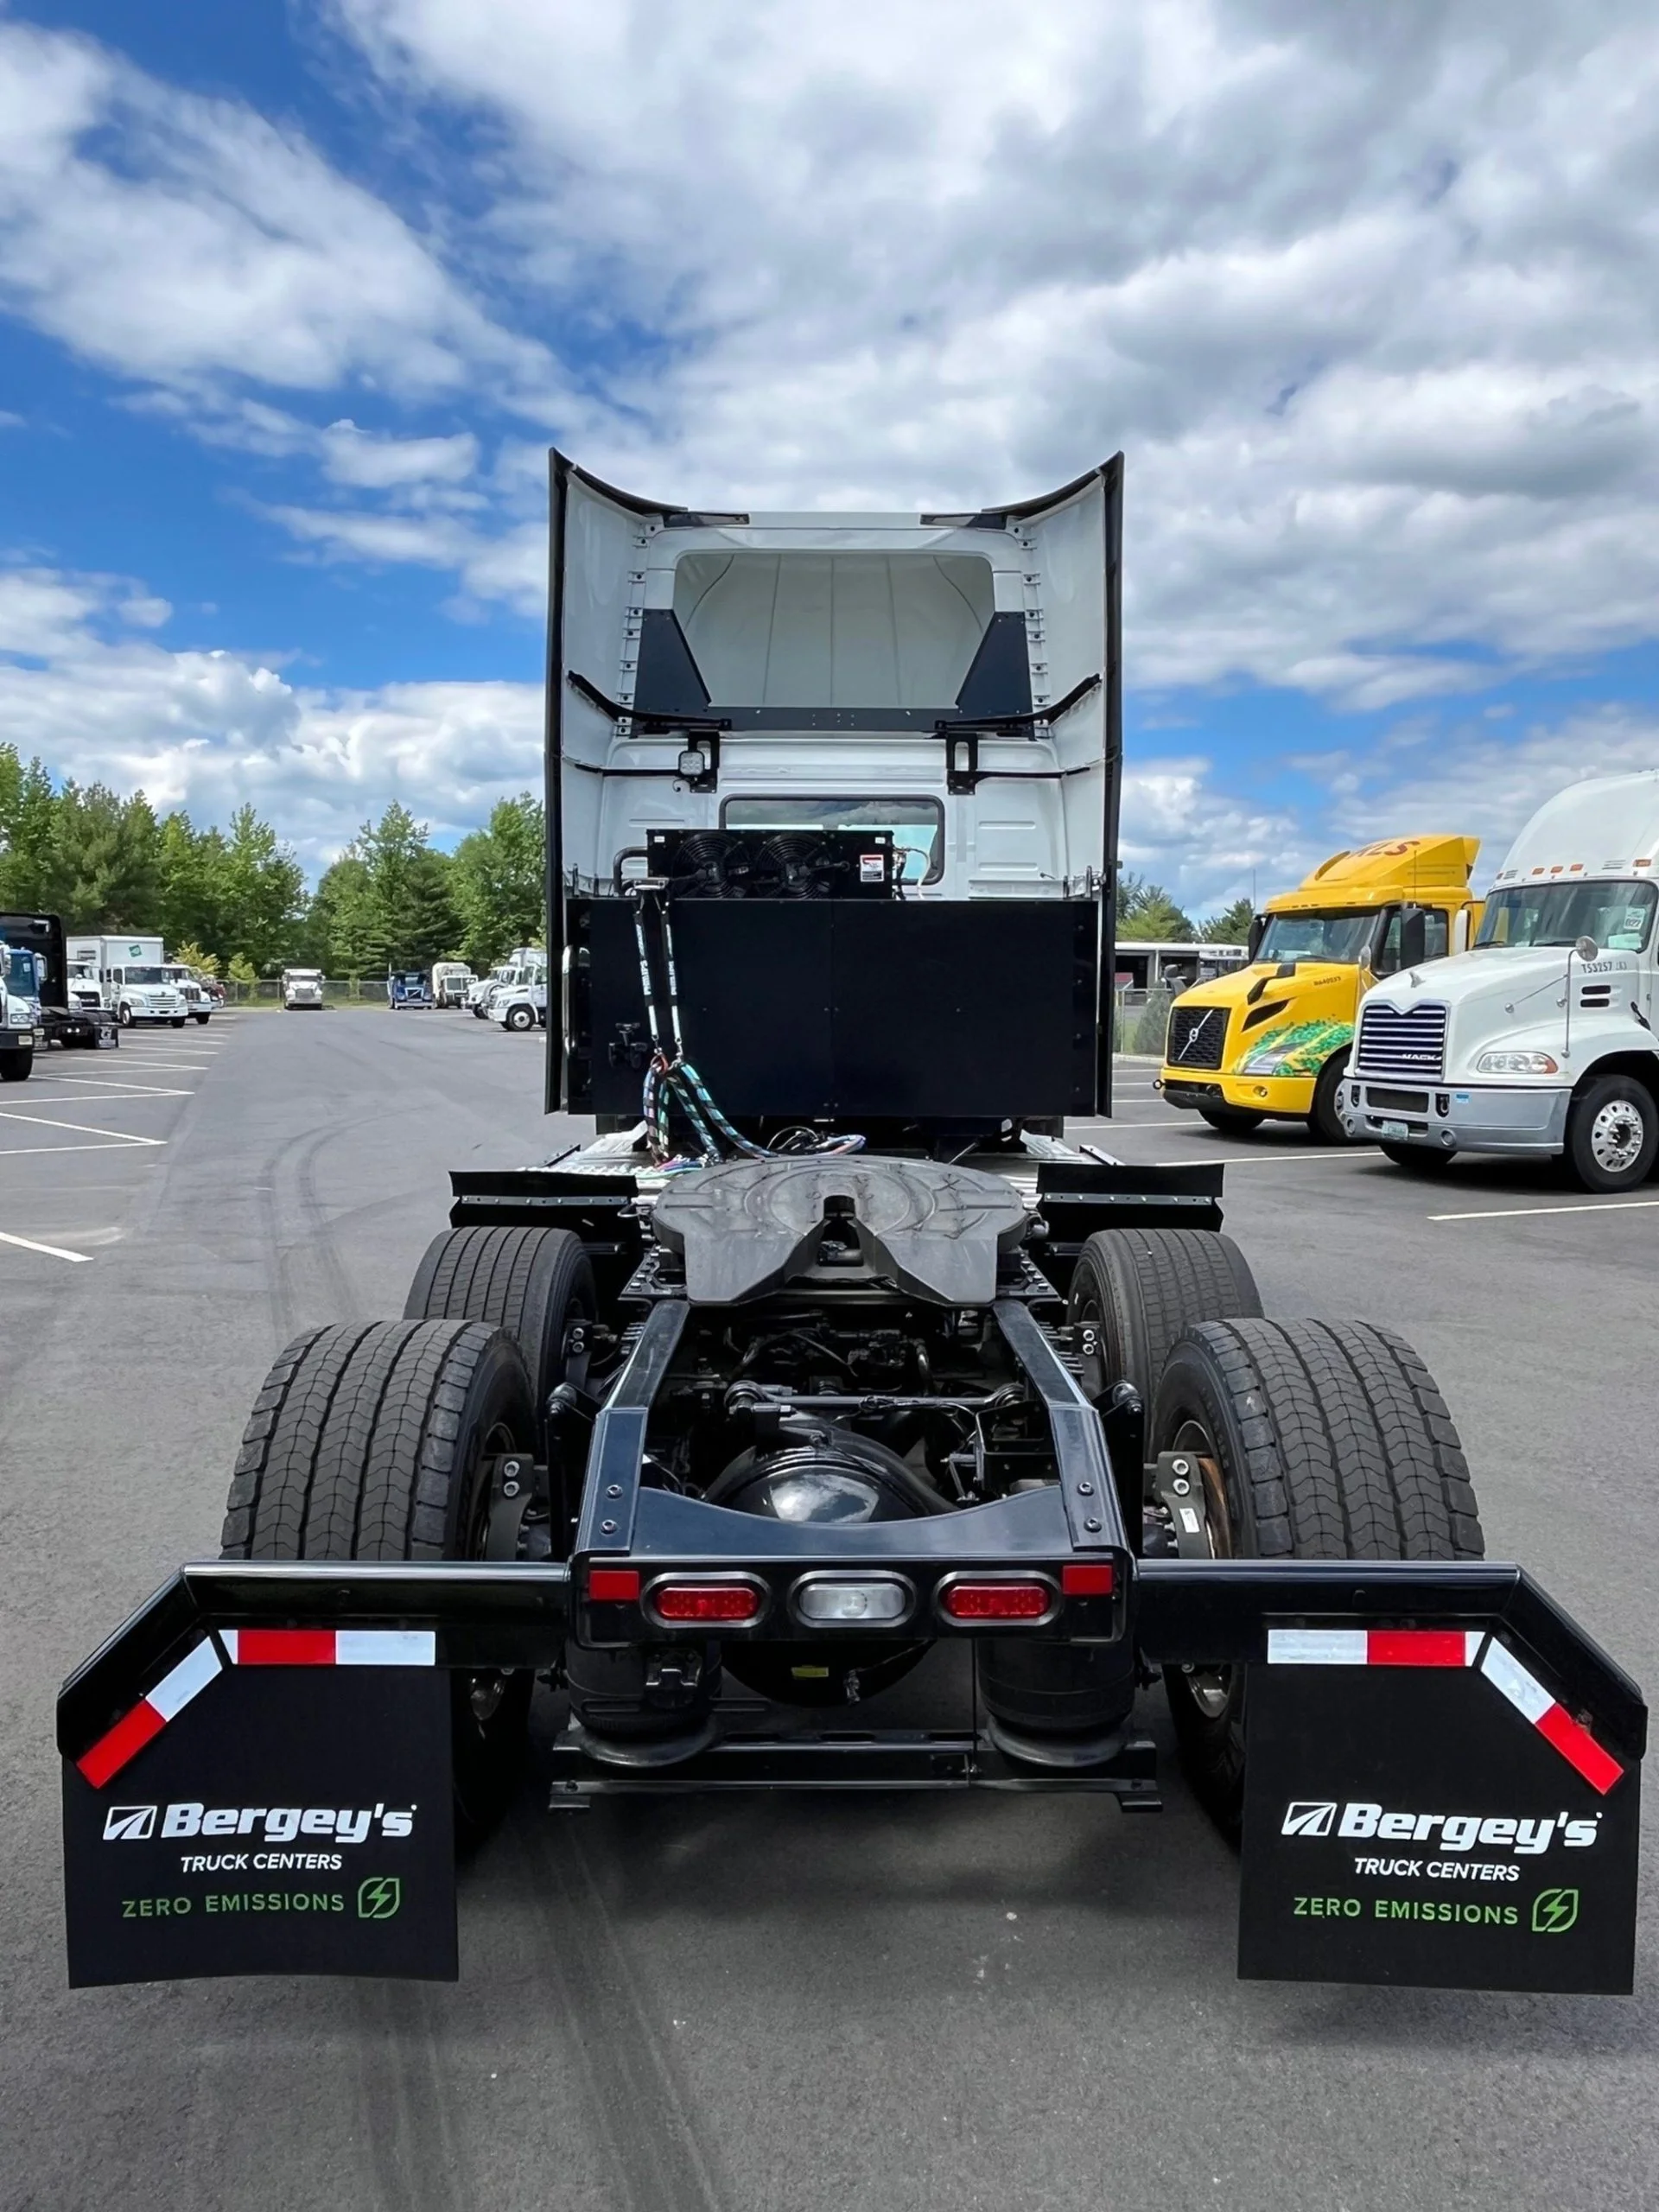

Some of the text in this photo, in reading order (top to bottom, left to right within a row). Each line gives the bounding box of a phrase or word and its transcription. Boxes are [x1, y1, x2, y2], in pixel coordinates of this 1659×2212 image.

[161, 1802, 413, 1844] Bergey's
[1338, 1802, 1599, 1855] Bergey's
[181, 1853, 342, 1873] TRUCK CENTERS
[1354, 1857, 1521, 1882] TRUCK CENTERS
[122, 1893, 345, 1918] ZERO EMISSIONS
[1294, 1897, 1519, 1925] ZERO EMISSIONS
